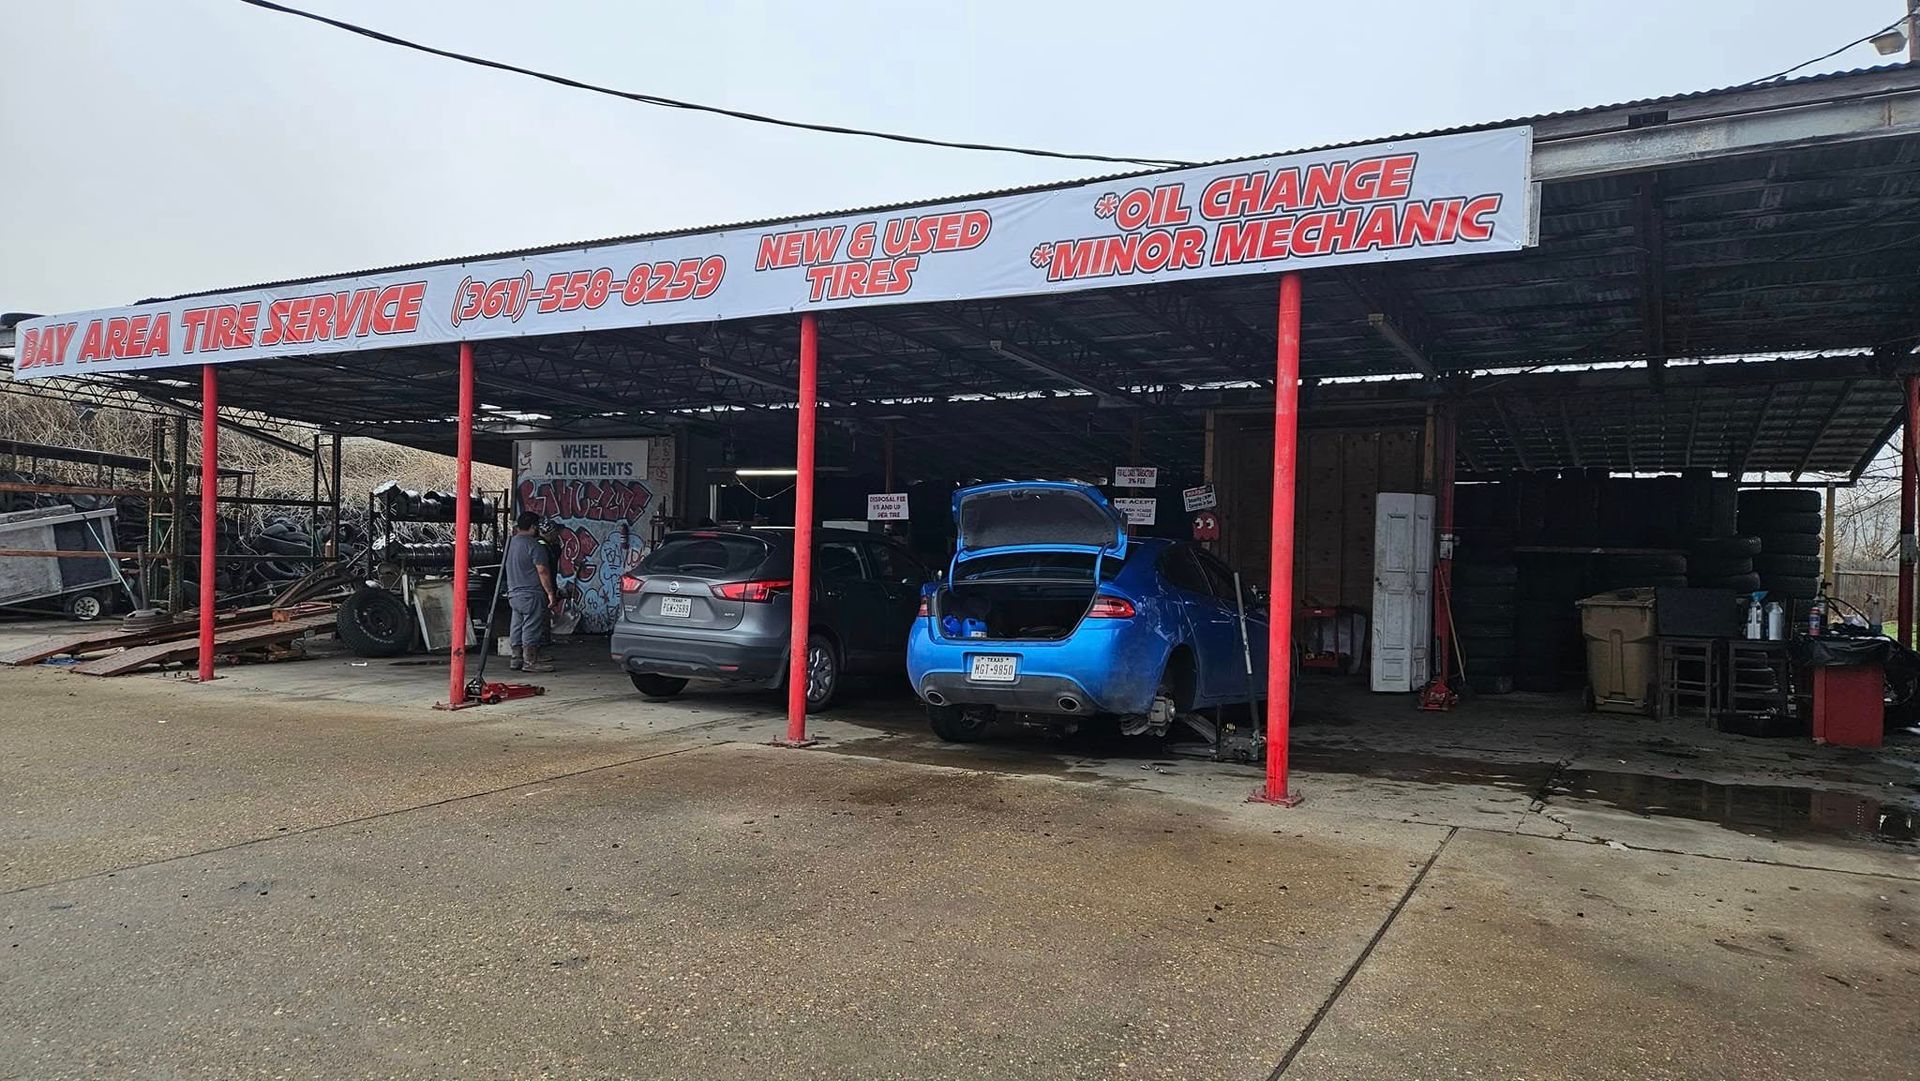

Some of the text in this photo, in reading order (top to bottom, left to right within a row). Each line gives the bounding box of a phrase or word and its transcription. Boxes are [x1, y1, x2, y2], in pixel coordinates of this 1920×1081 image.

[1199, 152, 1419, 222] CHANGE
[755, 209, 993, 271] NEW & USED
[1210, 193, 1502, 267] MECHANIC
[451, 255, 727, 328] (361)-558-8259
[805, 256, 919, 302] TIRES
[18, 281, 428, 370] BAY AREA TIRE SERVICE
[545, 461, 633, 476] ALIGNMENTS
[561, 444, 607, 459] WHEEL
